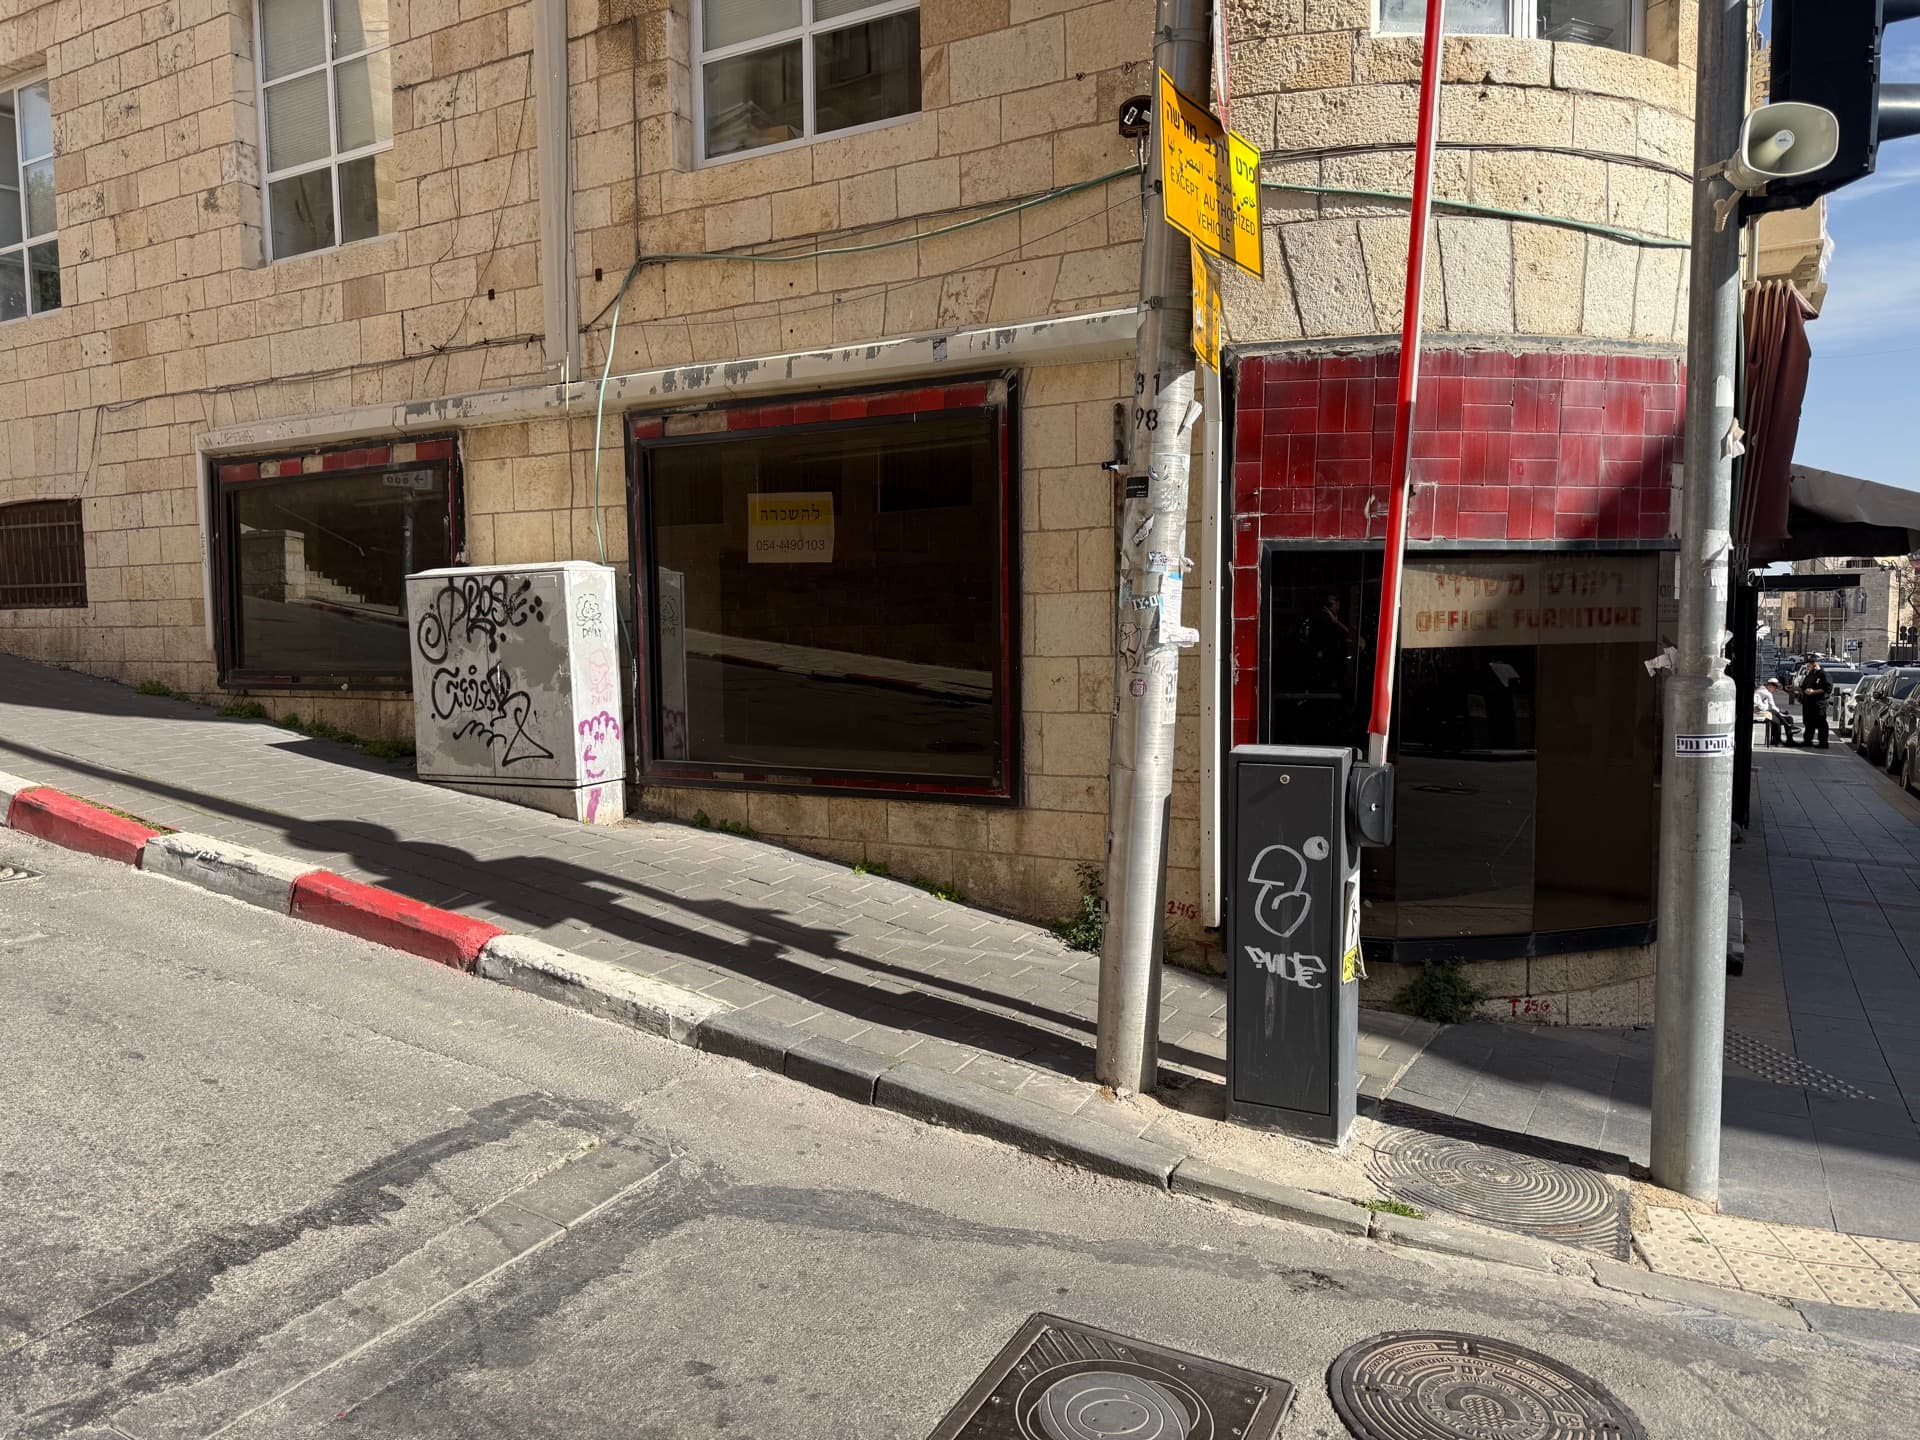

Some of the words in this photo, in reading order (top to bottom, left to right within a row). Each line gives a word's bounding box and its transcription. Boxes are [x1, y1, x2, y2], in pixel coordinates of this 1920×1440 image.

[1166, 101, 1198, 146] מורשה
[1204, 131, 1229, 169] לרכב
[1235, 155, 1256, 185] פרט
[1170, 169, 1199, 203] EXCEPT
[1203, 192, 1256, 236] AUTHORIZED
[1197, 211, 1231, 243] VEHICLE
[1135, 406, 1159, 432] 98
[760, 503, 820, 521] להשכרה
[1435, 573, 1524, 598] משרדי
[1415, 607, 1499, 632] OFFICE
[1513, 606, 1641, 630] FURNITURE
